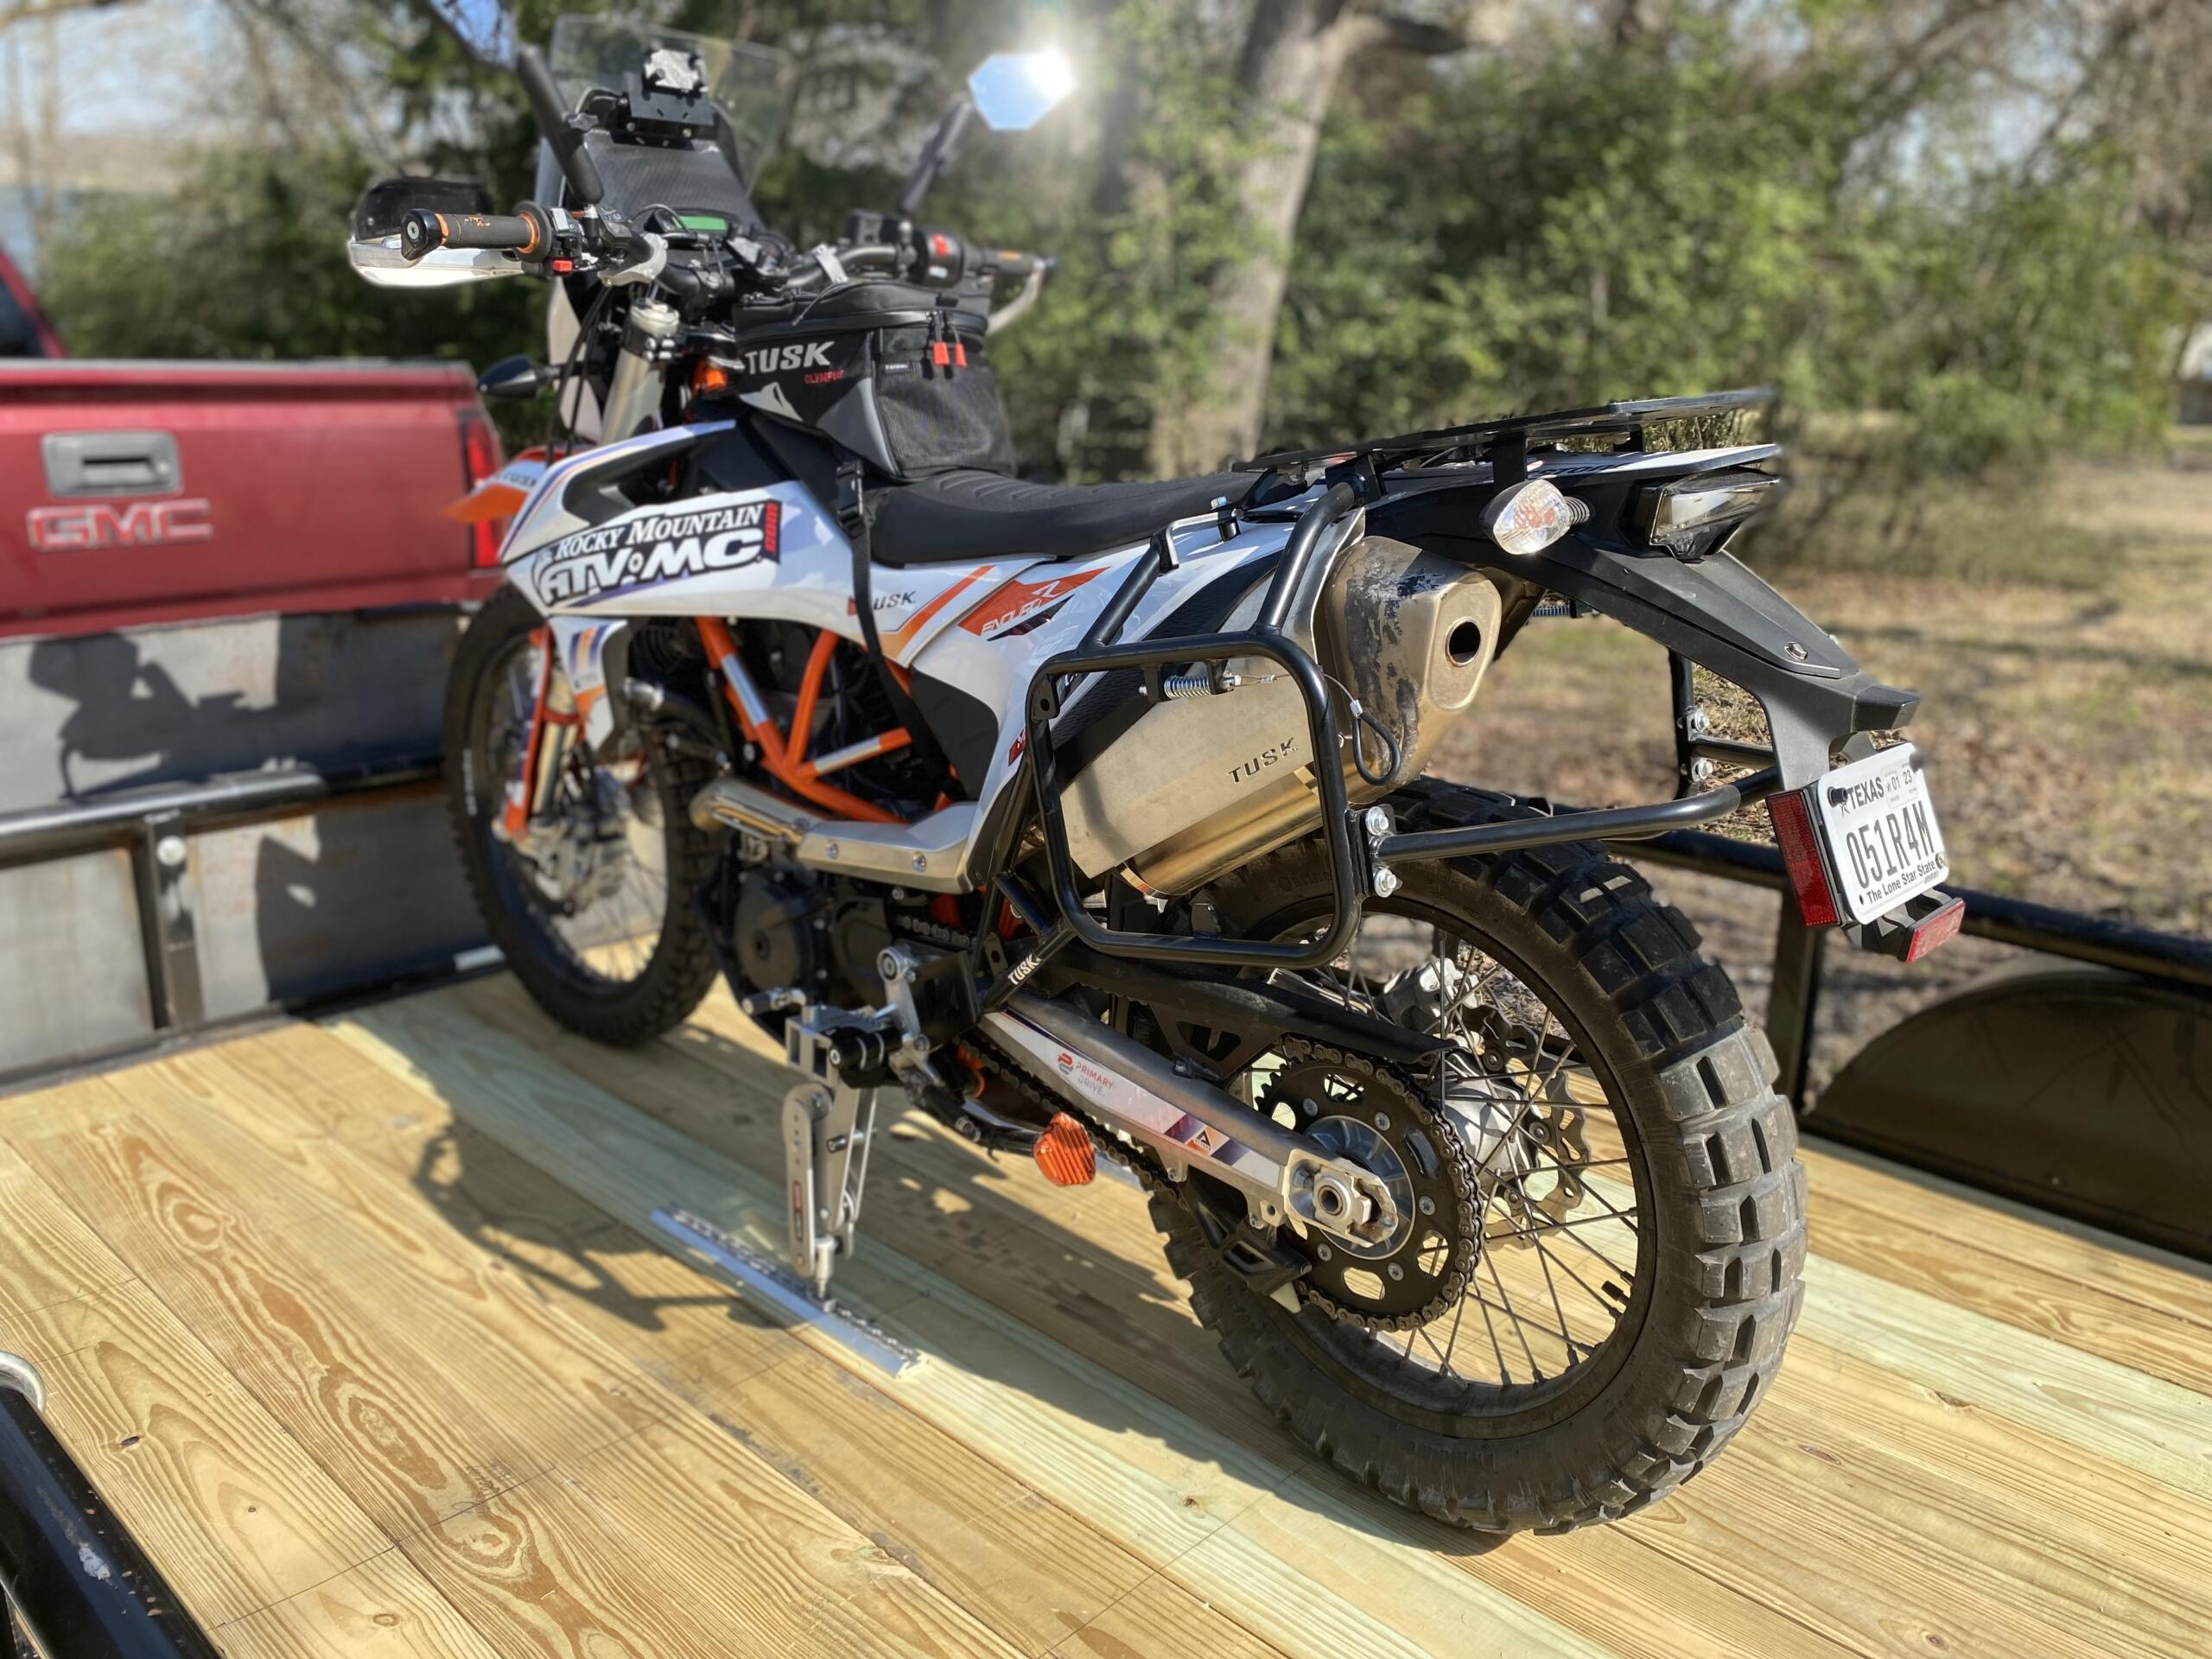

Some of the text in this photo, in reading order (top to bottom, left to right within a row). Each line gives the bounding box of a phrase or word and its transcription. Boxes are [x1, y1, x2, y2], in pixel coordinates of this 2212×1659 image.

[745, 341, 835, 375] TUSK
[28, 499, 213, 551] GMC
[554, 504, 765, 562] ROCKY MOUNTAIN
[873, 590, 917, 611] USK
[1227, 737, 1298, 785] TUSK
[1847, 776, 1885, 810] TEXAS
[1891, 776, 1901, 790] 01
[1903, 769, 1913, 785] 23
[1846, 800, 1936, 889] 051R4M
[1866, 888, 1883, 904] The
[1882, 876, 1901, 896] Lone
[1901, 868, 1917, 886] Star
[1916, 859, 1936, 877] State
[1007, 952, 1039, 985] TUSK
[1076, 1061, 1114, 1090] PRIMARY
